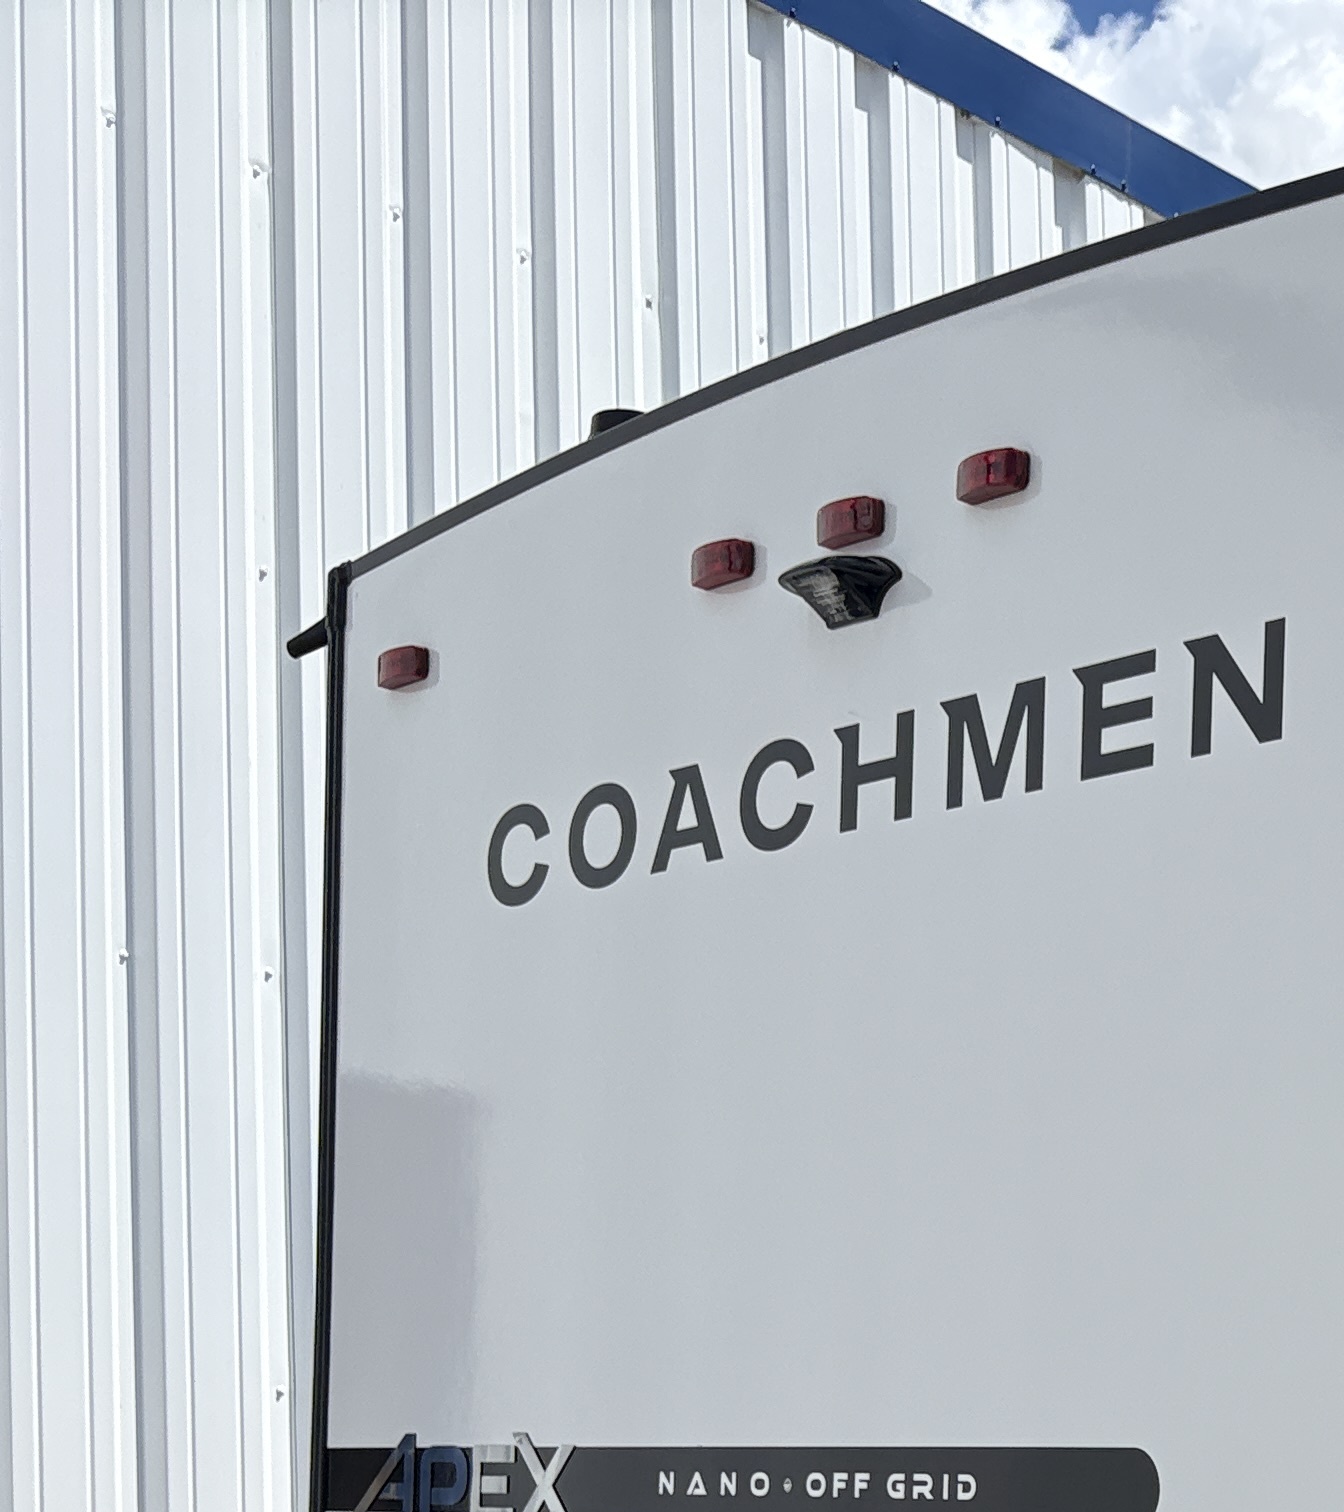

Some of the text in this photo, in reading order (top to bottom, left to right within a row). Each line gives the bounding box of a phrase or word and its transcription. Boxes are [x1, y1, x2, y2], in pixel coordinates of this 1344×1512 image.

[487, 616, 1287, 908] COACHMEN
[657, 1470, 979, 1503] NANO OFF GRID
